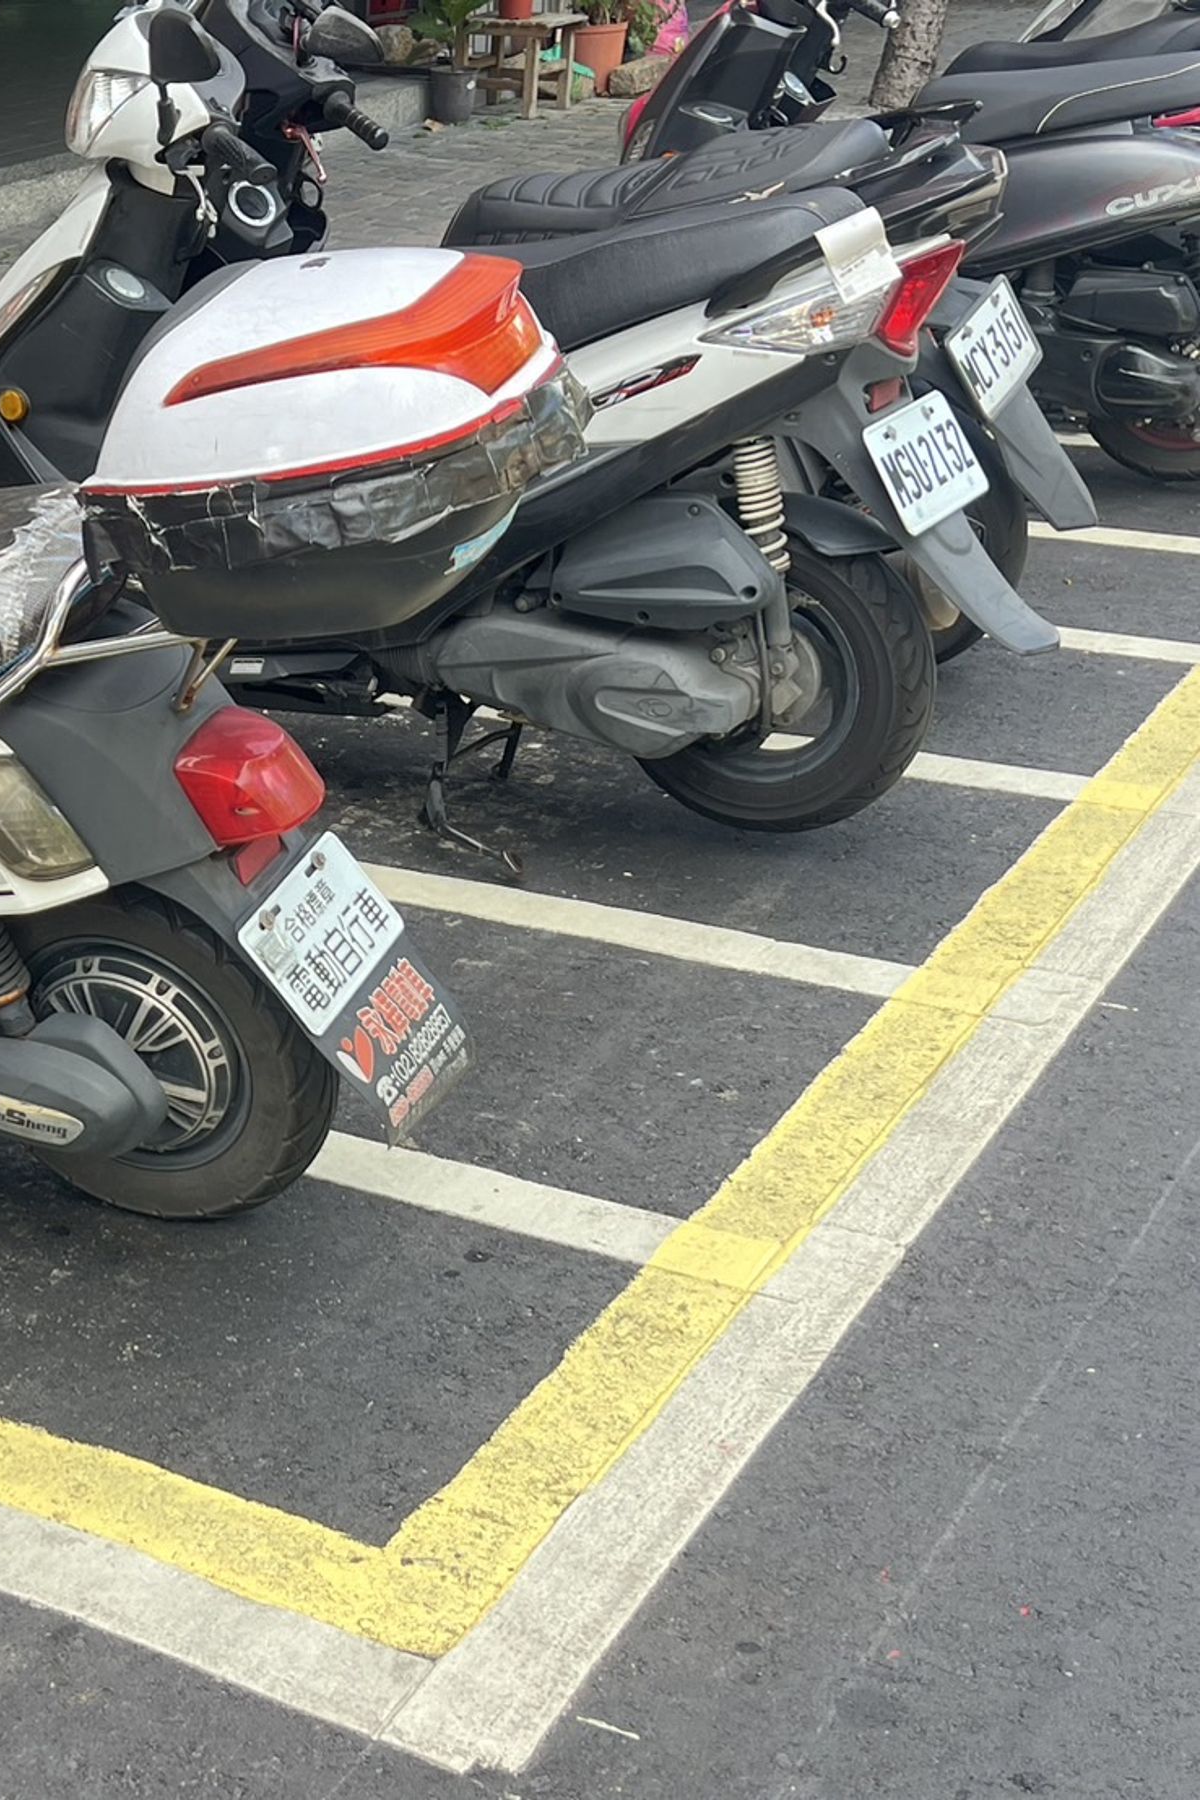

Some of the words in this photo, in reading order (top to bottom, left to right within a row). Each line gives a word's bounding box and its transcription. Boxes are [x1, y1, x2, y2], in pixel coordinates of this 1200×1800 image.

[284, 878, 336, 944] 合格標章
[285, 887, 390, 1012] 電動自行車
